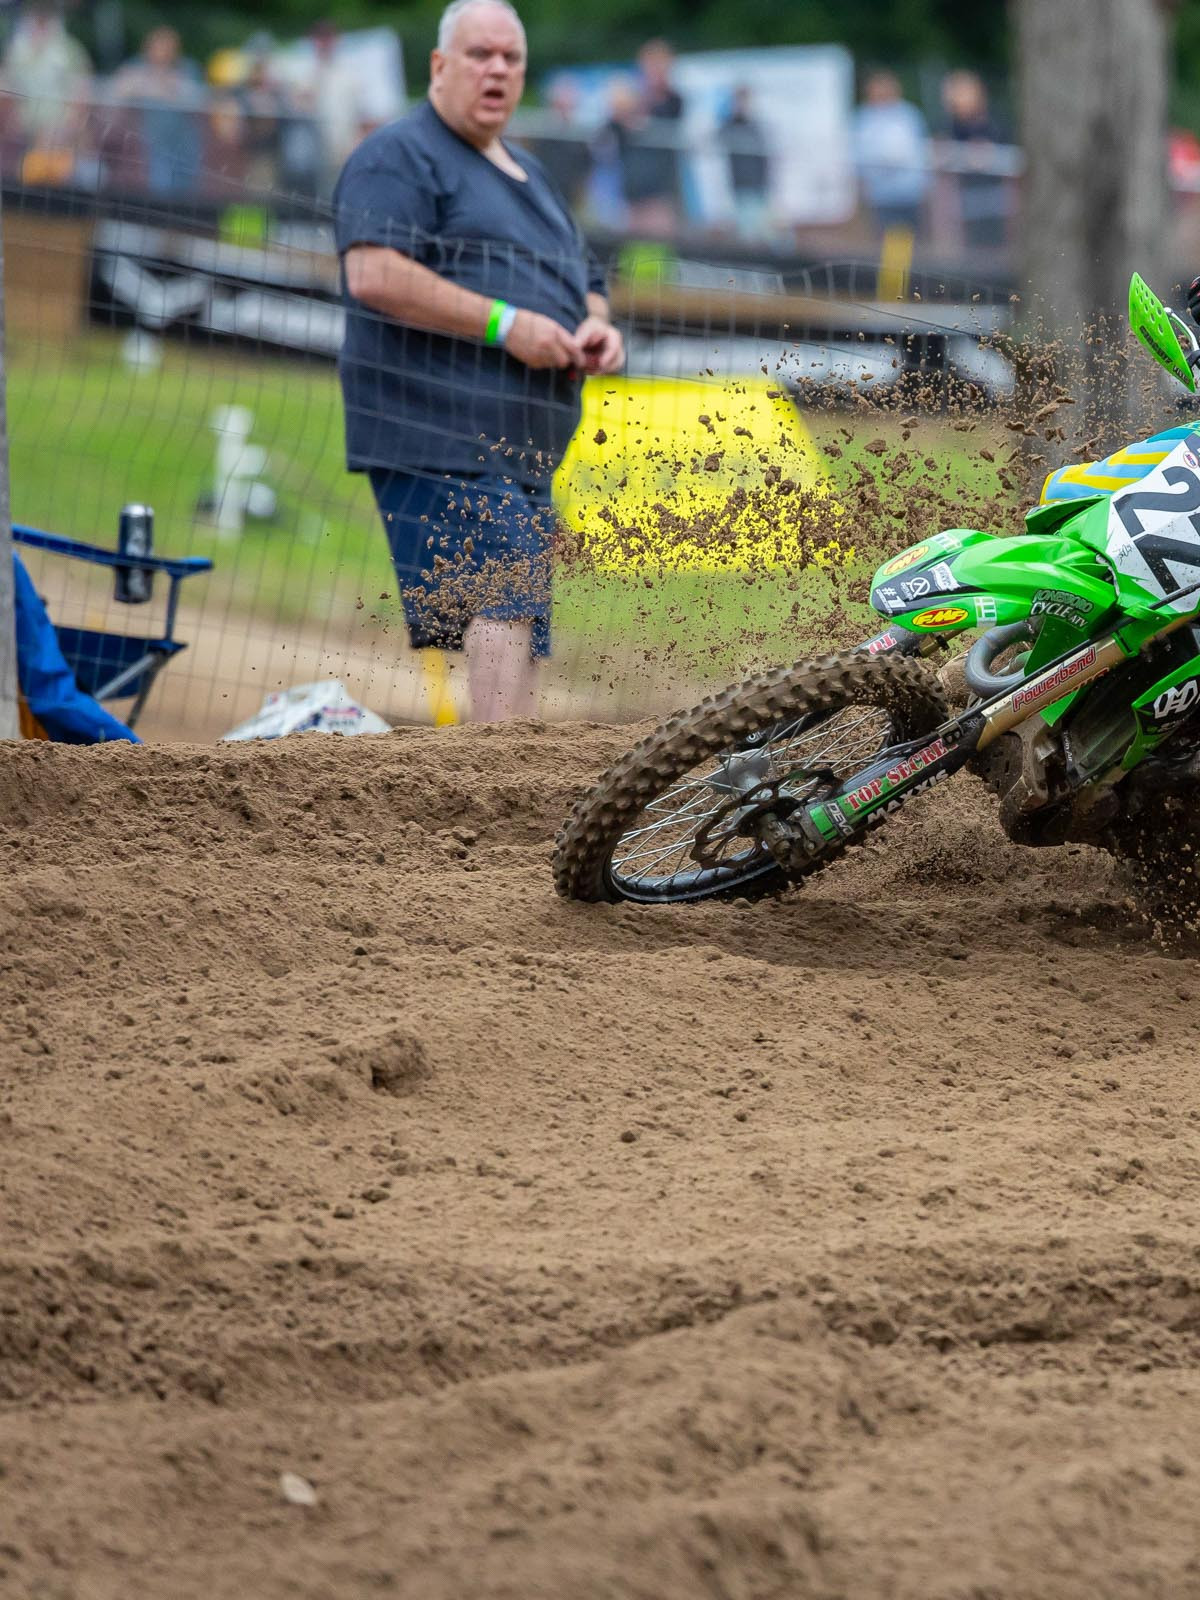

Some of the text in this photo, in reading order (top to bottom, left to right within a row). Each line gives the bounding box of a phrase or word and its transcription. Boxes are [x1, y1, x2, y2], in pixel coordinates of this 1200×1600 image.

[882, 587, 906, 608] #1
[1031, 602, 1072, 618] CYCLE
[913, 609, 966, 625] FMF
[1013, 645, 1096, 712] Powerband
[845, 738, 959, 810] TOP SECRE
[867, 769, 950, 824] MAXXIS
